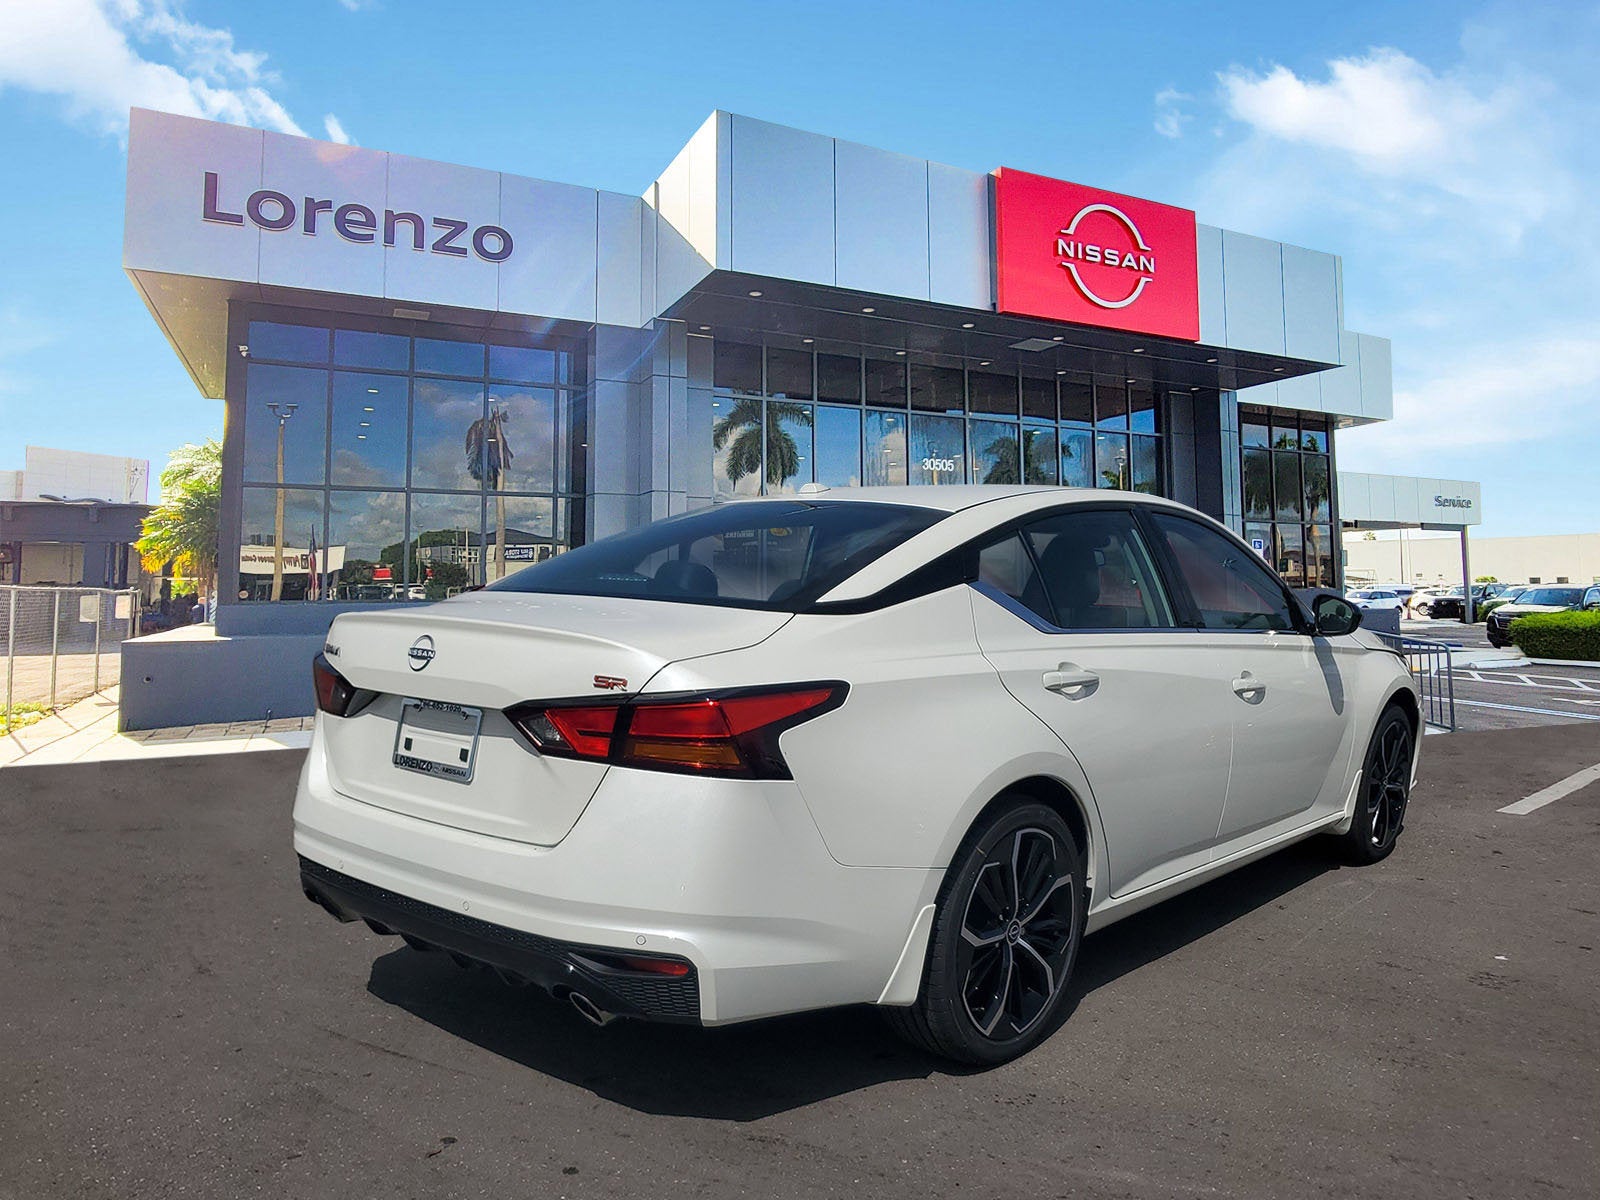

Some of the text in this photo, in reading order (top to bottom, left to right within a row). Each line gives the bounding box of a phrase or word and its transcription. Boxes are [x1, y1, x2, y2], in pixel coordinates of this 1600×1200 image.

[201, 170, 514, 262] Lorenzo
[1057, 238, 1155, 273] NISSAN
[922, 457, 955, 471] 30505
[1433, 495, 1472, 508] Service
[593, 674, 628, 691] SR
[393, 753, 467, 777] LORENZO NISSAN
